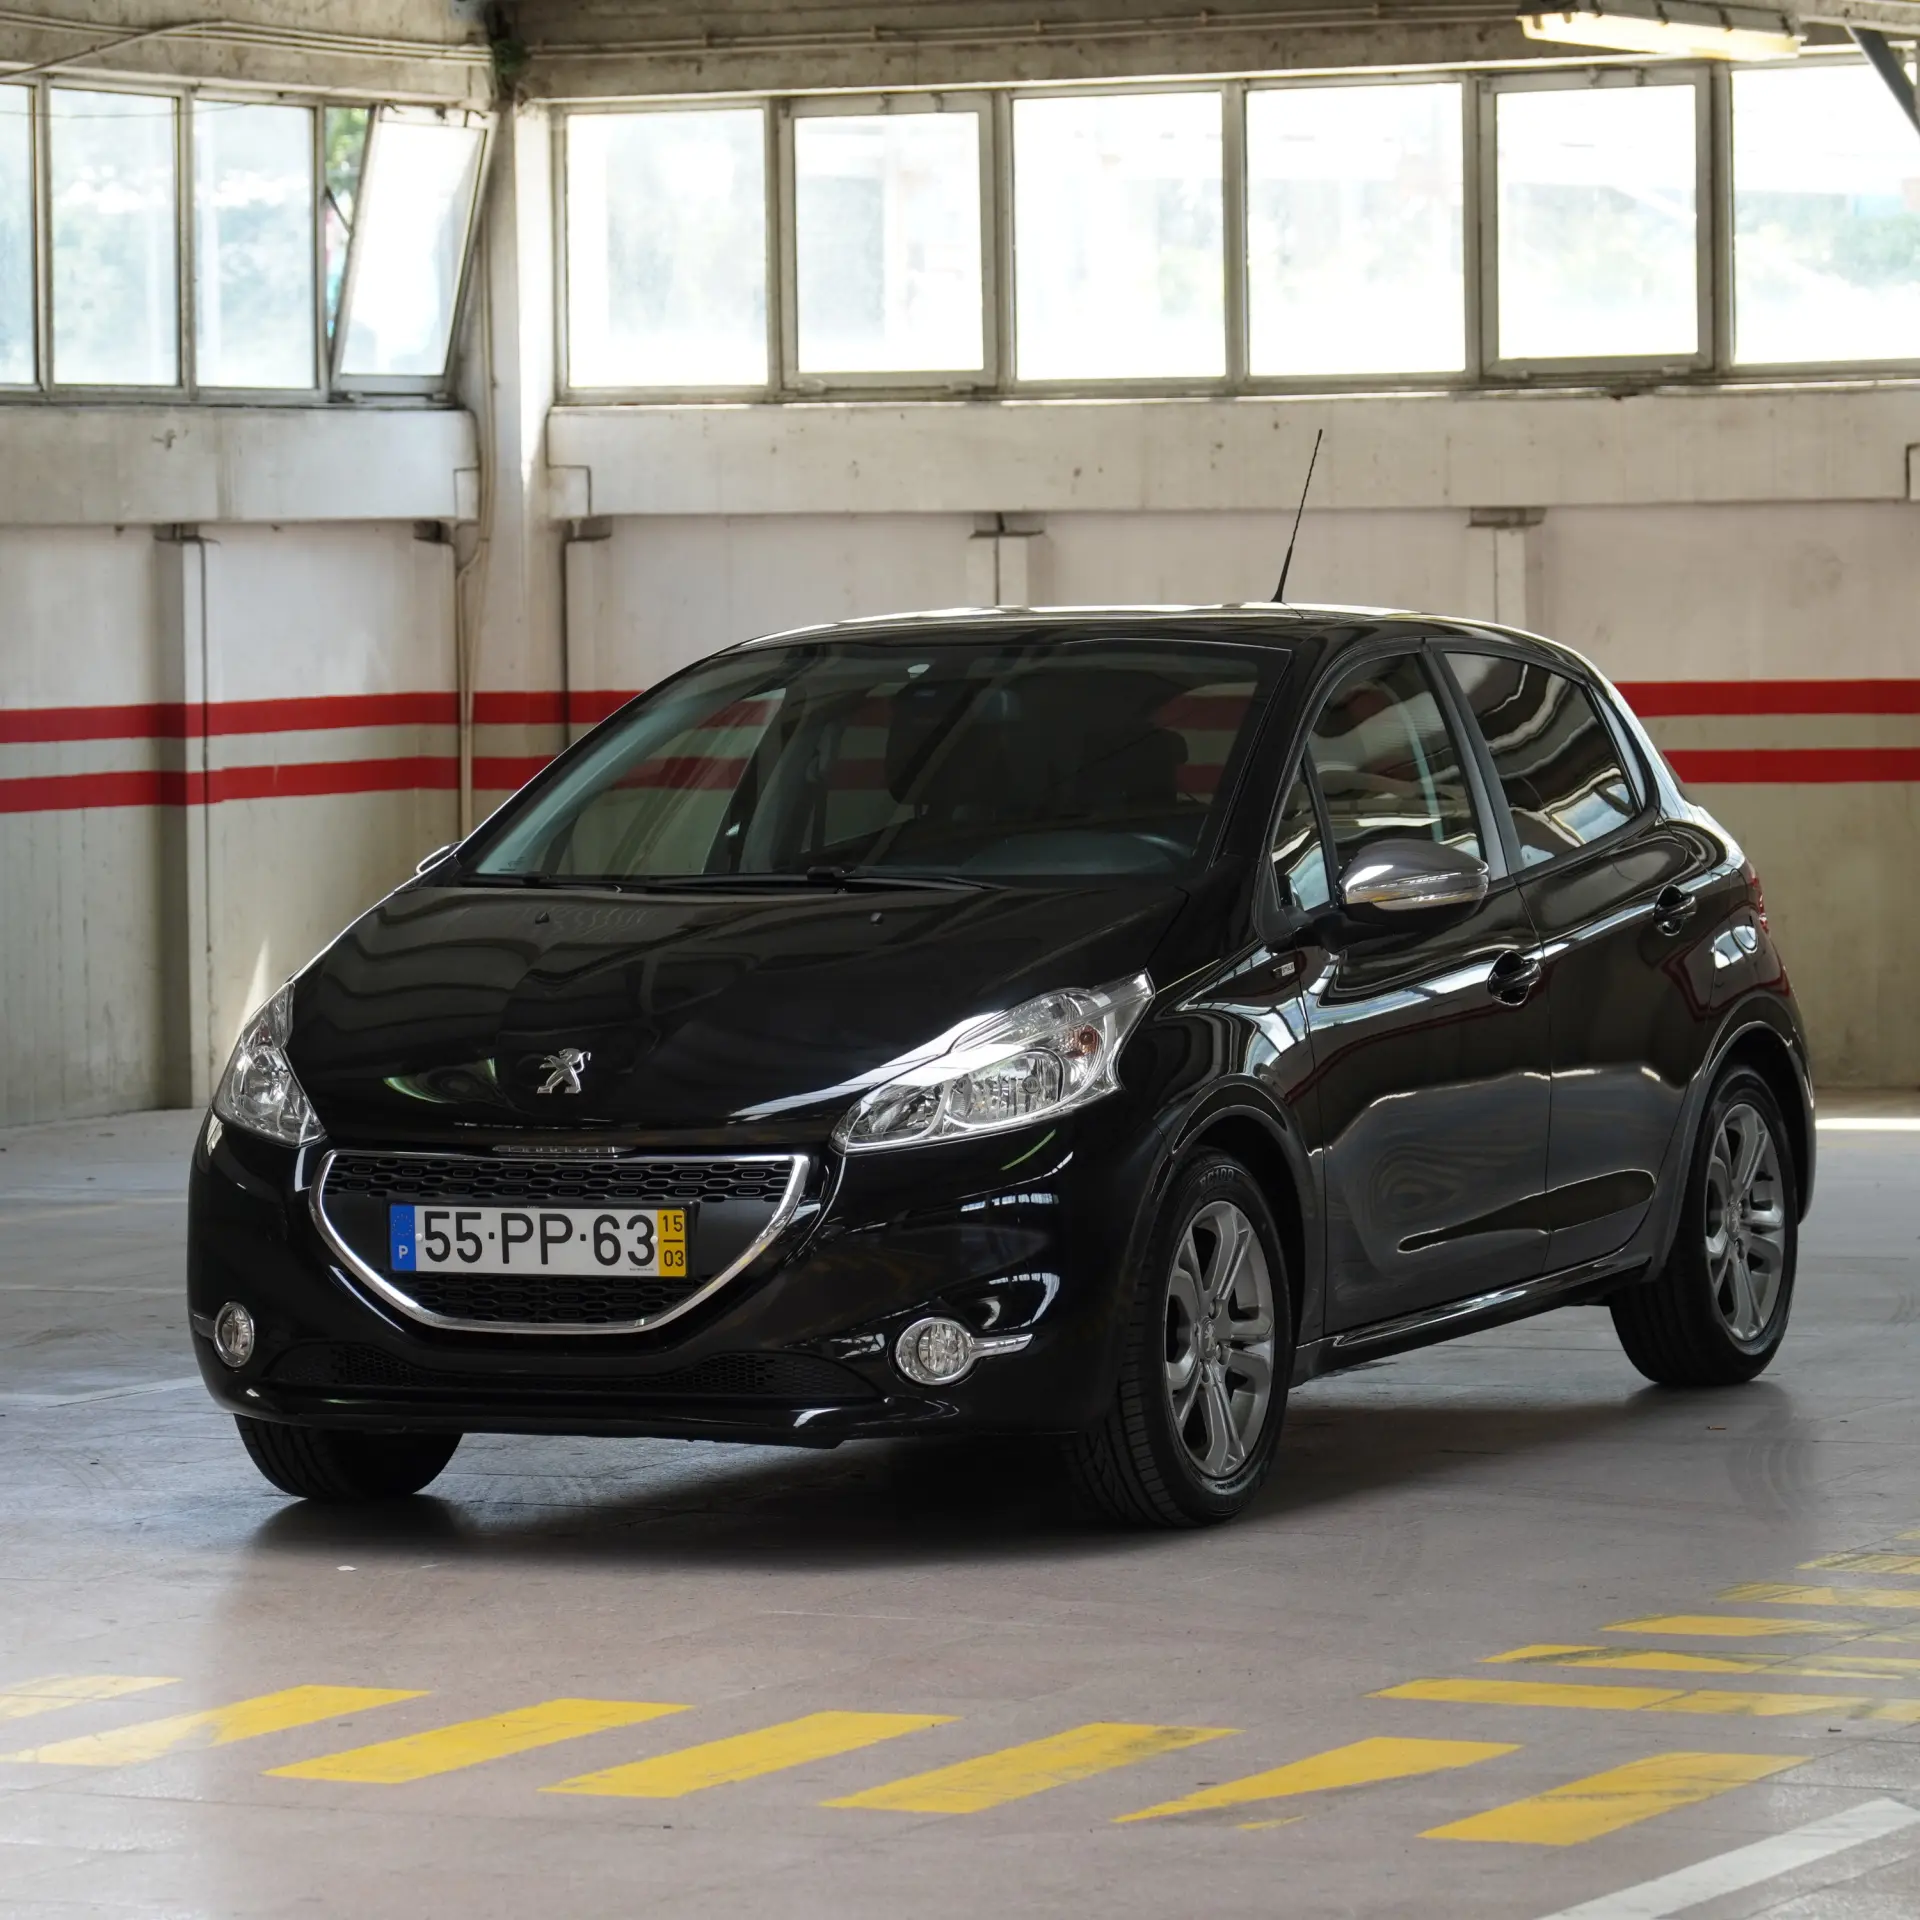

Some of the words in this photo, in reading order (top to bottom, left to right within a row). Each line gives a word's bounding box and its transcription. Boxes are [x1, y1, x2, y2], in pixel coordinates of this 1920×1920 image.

[662, 1215, 683, 1233] 15
[398, 1245, 409, 1260] P
[663, 1250, 685, 1268] 03
